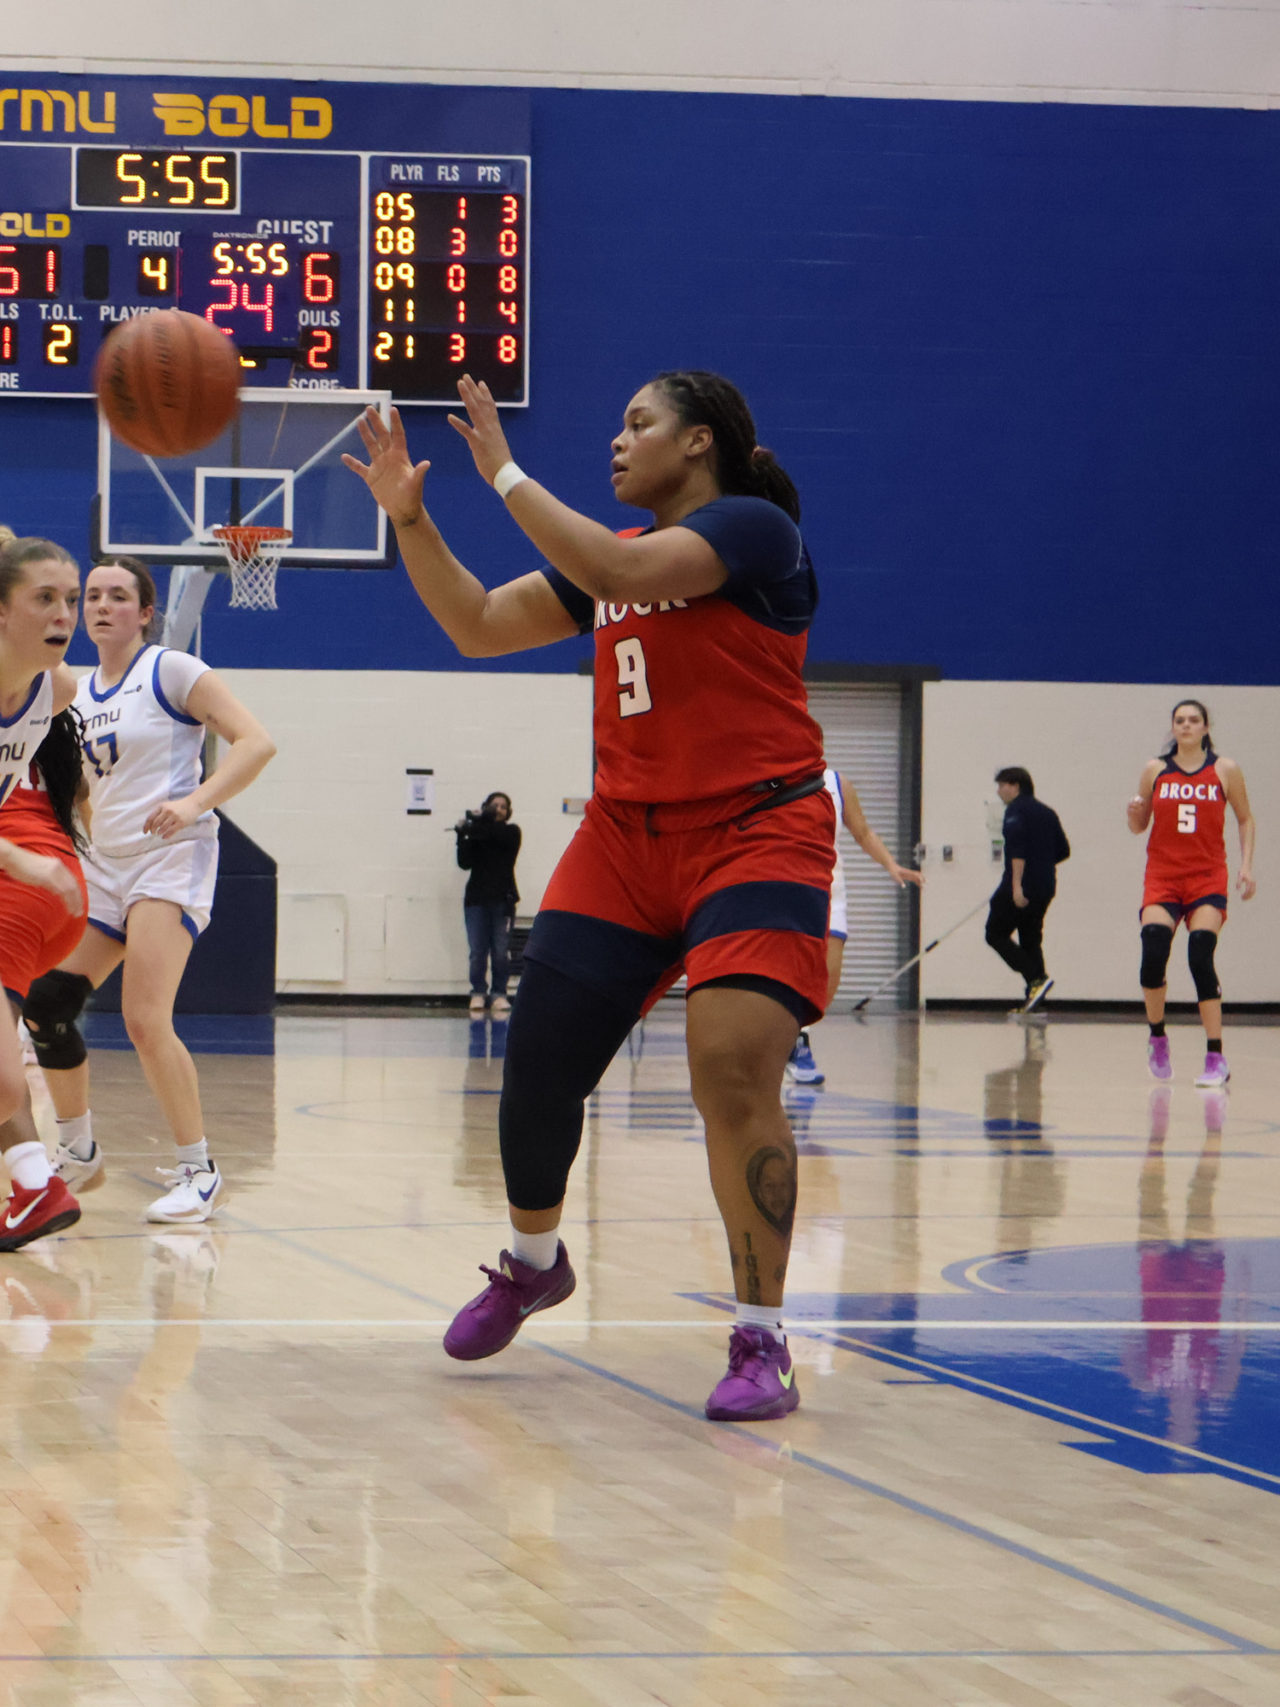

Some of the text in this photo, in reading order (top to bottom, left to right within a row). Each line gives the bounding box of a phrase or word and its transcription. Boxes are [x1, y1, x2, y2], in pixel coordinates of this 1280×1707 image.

[152, 93, 333, 140] BOLD
[116, 153, 230, 205] 5:55
[390, 164, 501, 182] PLYR FLS PTS
[375, 192, 517, 223] 05 1 3
[375, 226, 517, 257] 08 3 0
[142, 256, 168, 291] 4
[213, 242, 289, 276] 5:55
[375, 262, 517, 294] 09 0 8
[39, 305, 83, 321] T.O.L.
[100, 305, 160, 321] PLAY
[205, 278, 274, 335] 24
[298, 310, 340, 326] OULS
[385, 298, 517, 324] 11 1 4
[2, 325, 11, 359] 1
[47, 324, 72, 364] 2
[308, 330, 332, 368] 2
[374, 331, 517, 363] 21 3 8
[289, 378, 339, 390] SCORE
[614, 635, 653, 720] 9
[1159, 782, 1218, 801] BROCK
[1177, 803, 1197, 834] 5
